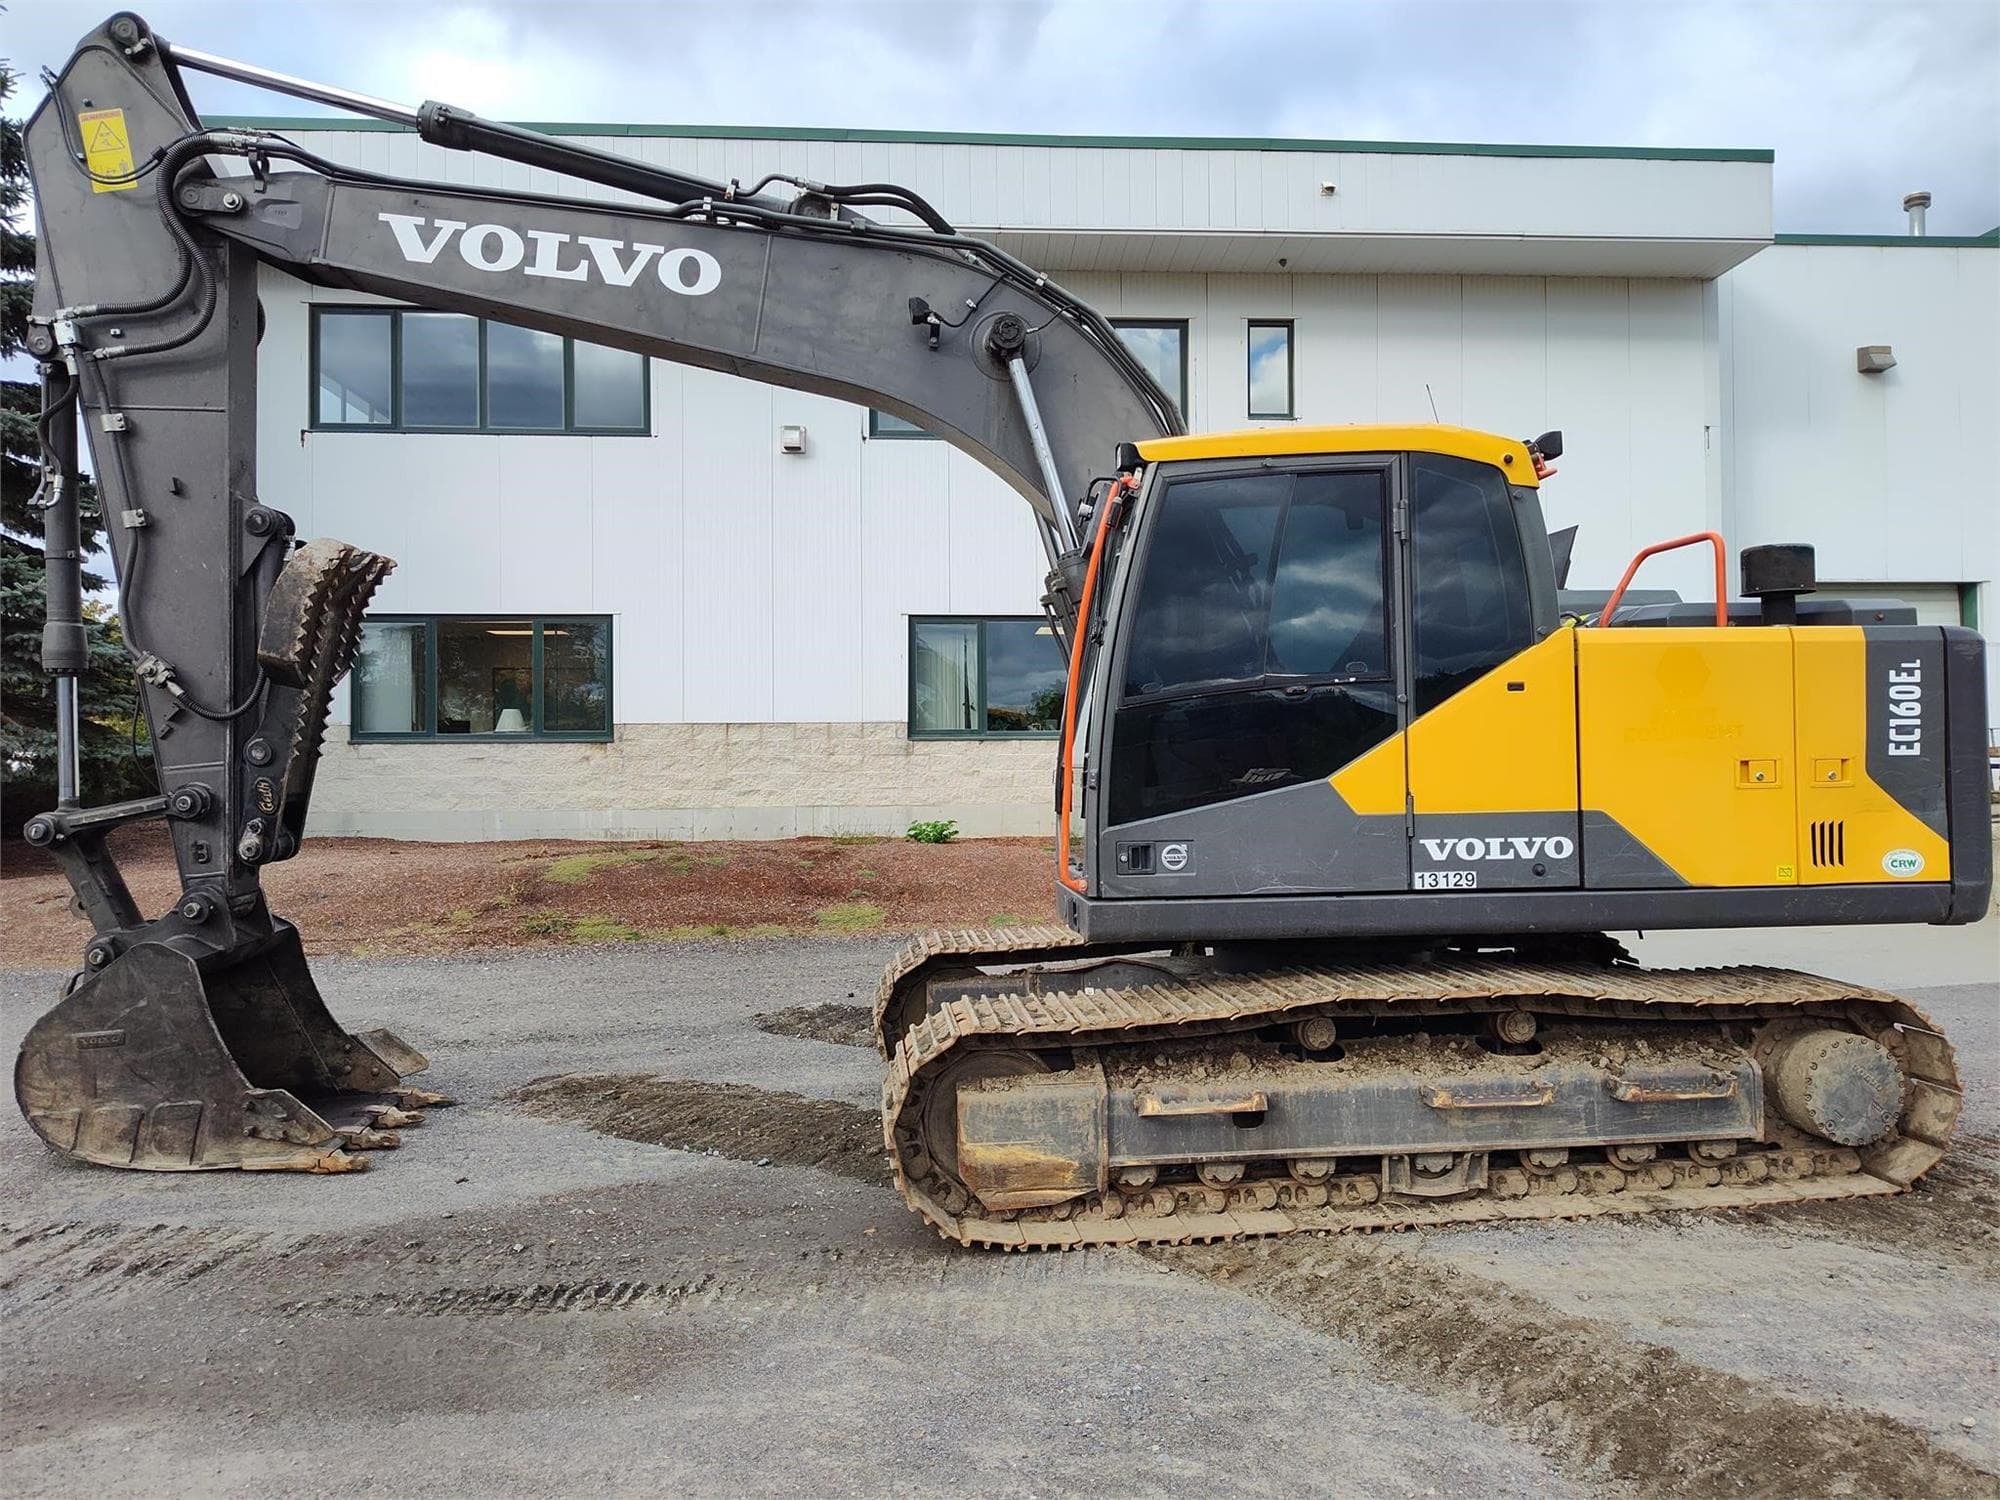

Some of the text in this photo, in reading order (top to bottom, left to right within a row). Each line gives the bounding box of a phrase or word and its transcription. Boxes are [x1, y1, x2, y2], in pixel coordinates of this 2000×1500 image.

[378, 212, 722, 296] VOLVO
[1888, 659, 1921, 756] EC160EL
[1419, 836, 1574, 861] VOLVO
[1890, 859, 1917, 868] CRW
[1417, 872, 1475, 888] 13129
